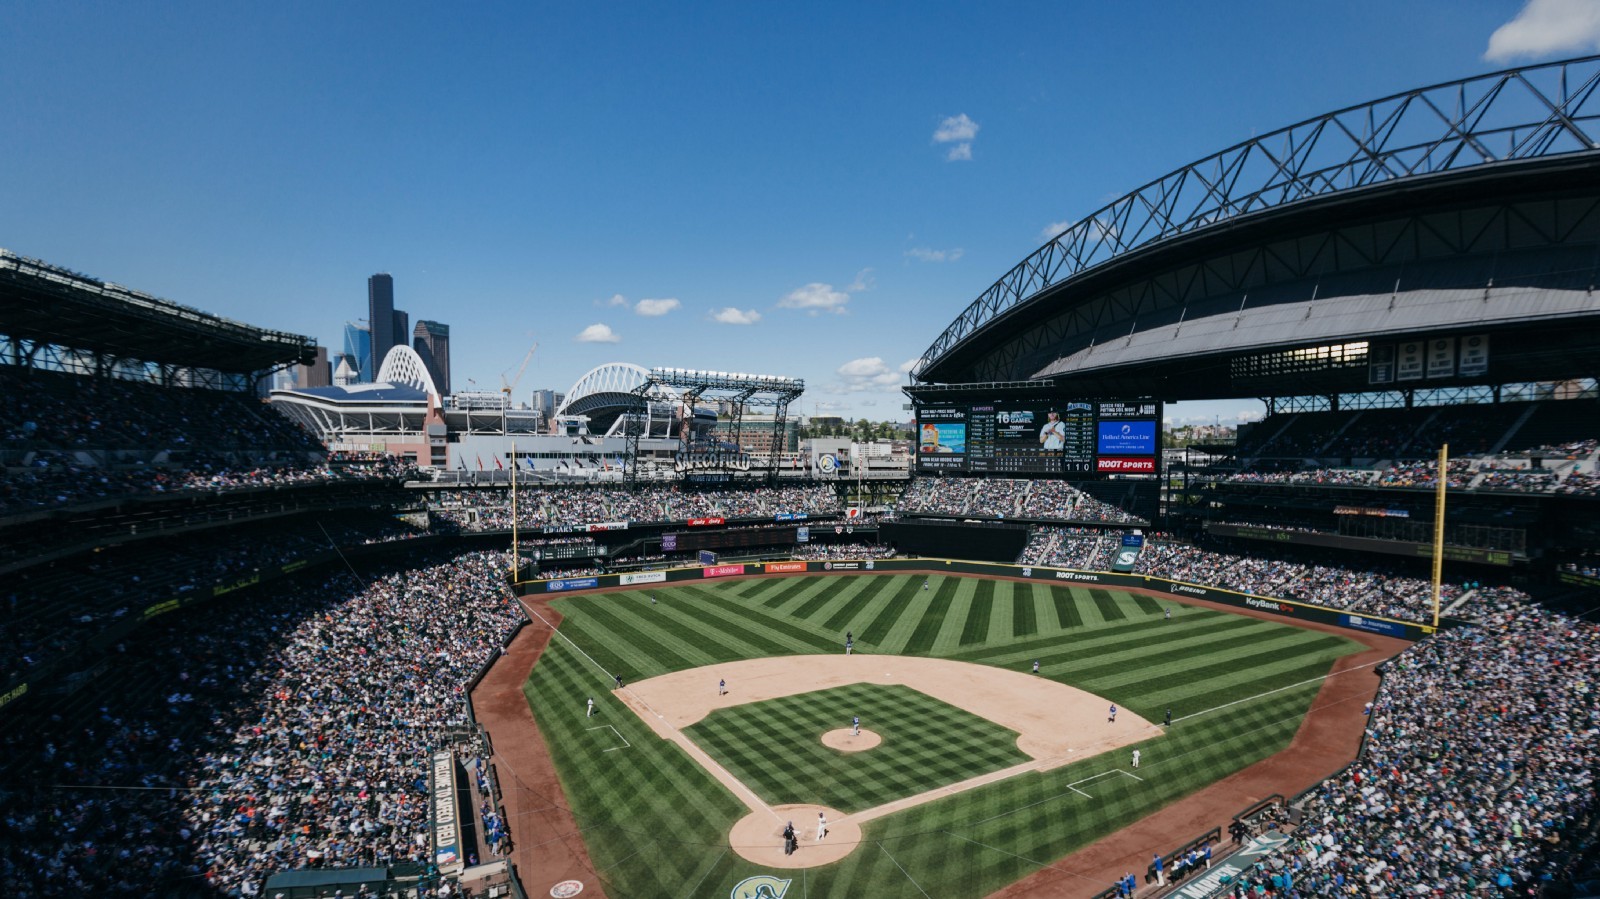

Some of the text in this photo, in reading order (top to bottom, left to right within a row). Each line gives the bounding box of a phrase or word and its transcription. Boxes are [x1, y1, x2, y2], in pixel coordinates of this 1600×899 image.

[996, 414, 1010, 424] 16
[674, 453, 751, 472] SAFECO FIELD
[1098, 460, 1153, 469] ROOT SPORTS
[1056, 571, 1075, 579] ROOT
[1179, 585, 1206, 594] BOEING
[1246, 597, 1280, 610] KeyBank
[434, 759, 452, 789] WELCOME
[436, 797, 454, 824] SAFECO
[437, 823, 456, 847] FIELD
